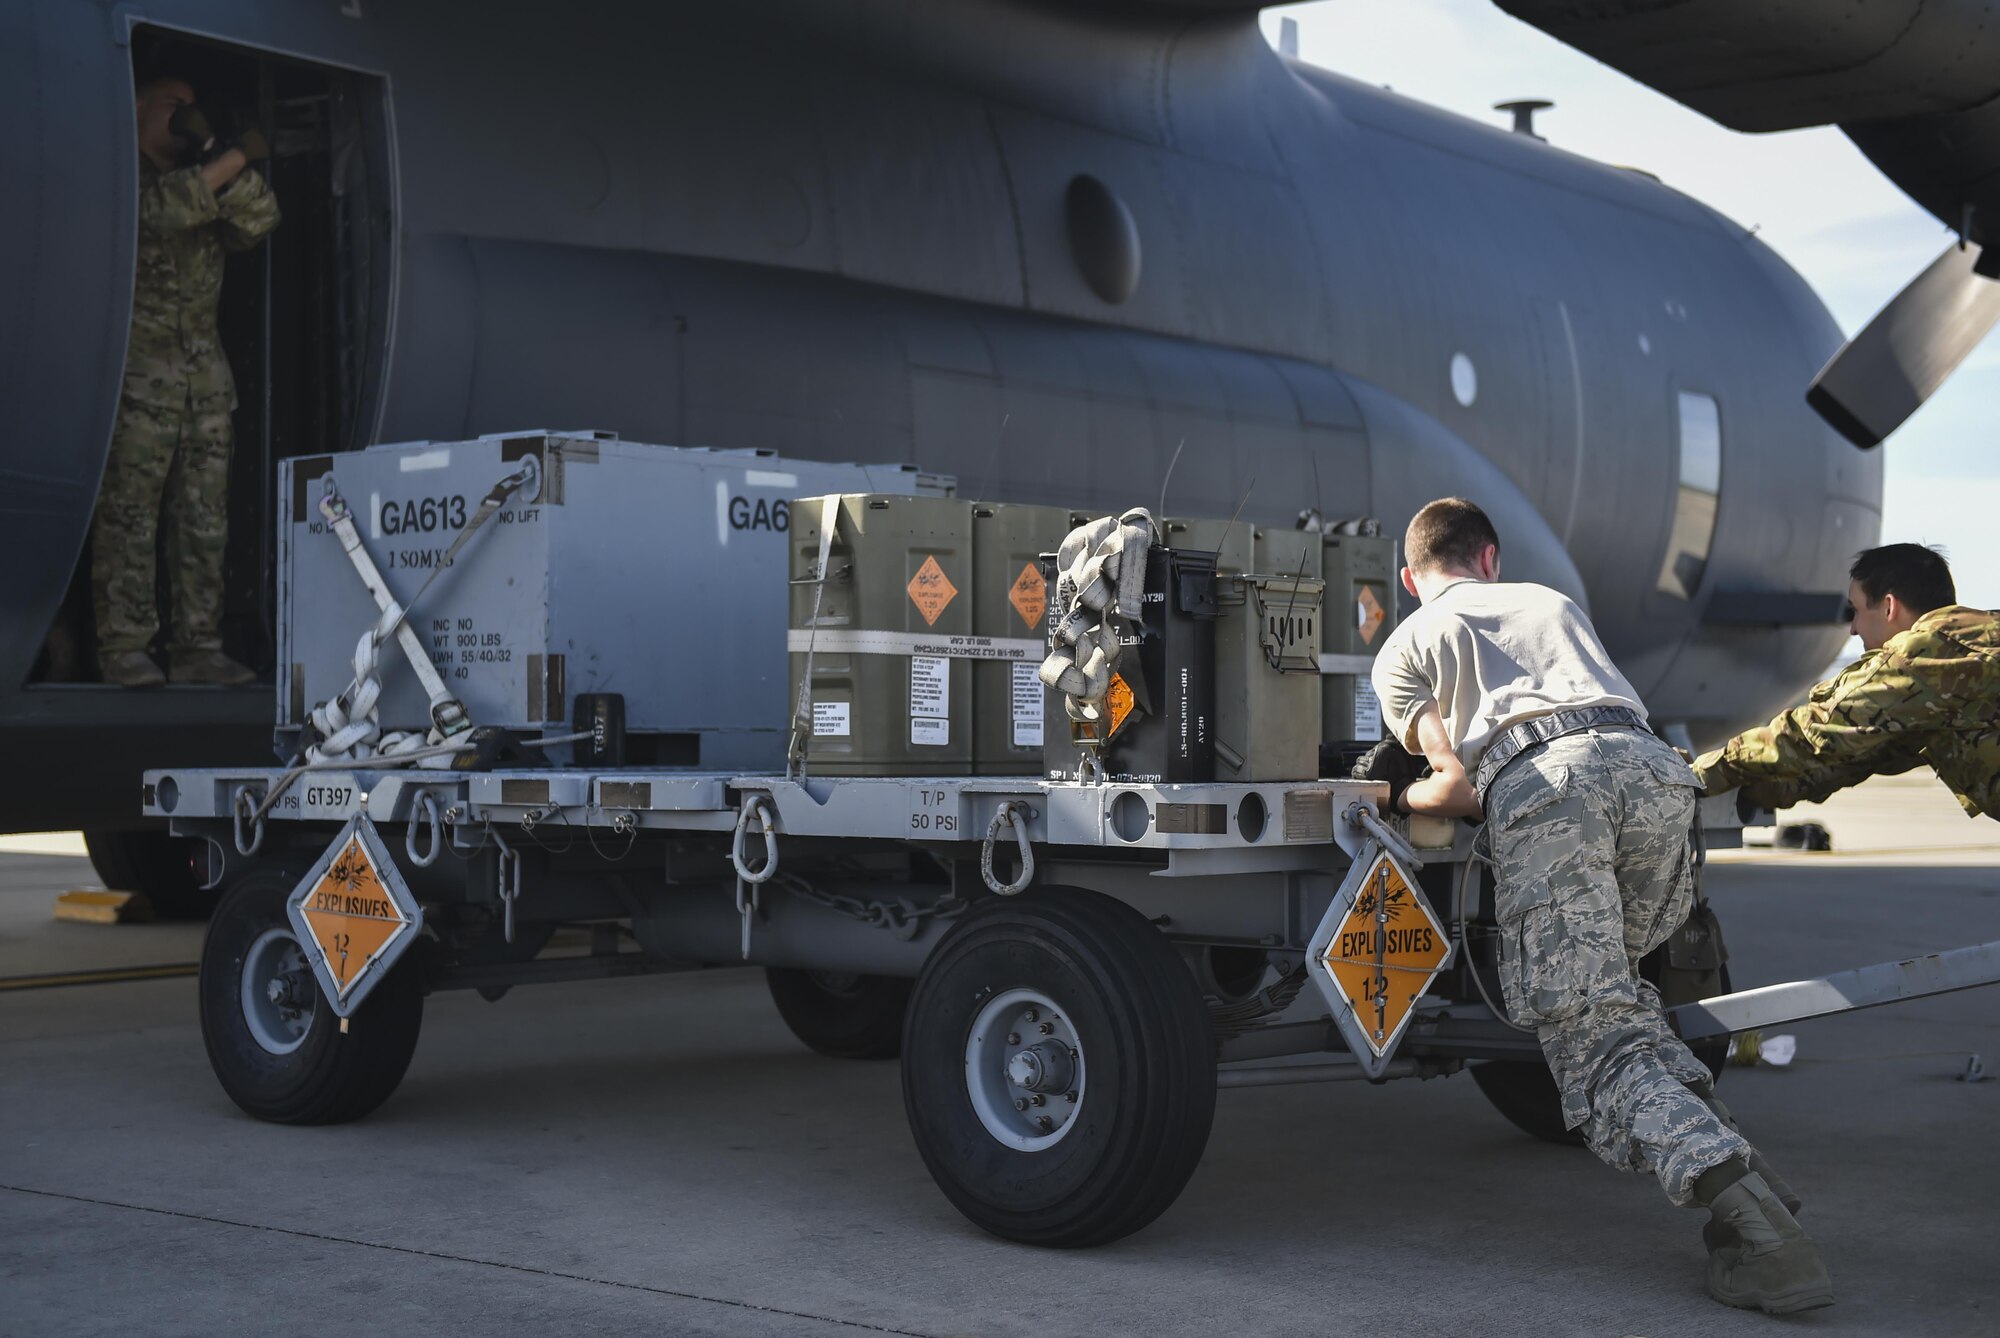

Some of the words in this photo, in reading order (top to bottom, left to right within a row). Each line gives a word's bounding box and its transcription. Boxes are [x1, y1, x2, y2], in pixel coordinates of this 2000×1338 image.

[380, 494, 467, 536] GA613
[498, 510, 515, 524] NO
[518, 508, 540, 523] LIFT
[728, 495, 789, 533] GA6
[308, 523, 323, 535] NO
[433, 618, 450, 632] INC
[457, 617, 473, 631] NO
[433, 634, 449, 648] WT
[457, 633, 477, 647] 900
[481, 632, 501, 647] LBS
[432, 651, 454, 665] LWH
[461, 648, 512, 664] 55/40/32
[454, 666, 469, 680] 40
[284, 796, 300, 809] PSI
[307, 787, 352, 806] GT397
[920, 789, 946, 807] T/P
[911, 813, 930, 830] 50
[935, 814, 958, 831] PSI
[316, 892, 389, 918] EXPLOSIVES
[1342, 927, 1433, 957] EXPLOSIVES
[1362, 975, 1389, 1003] 1.2
